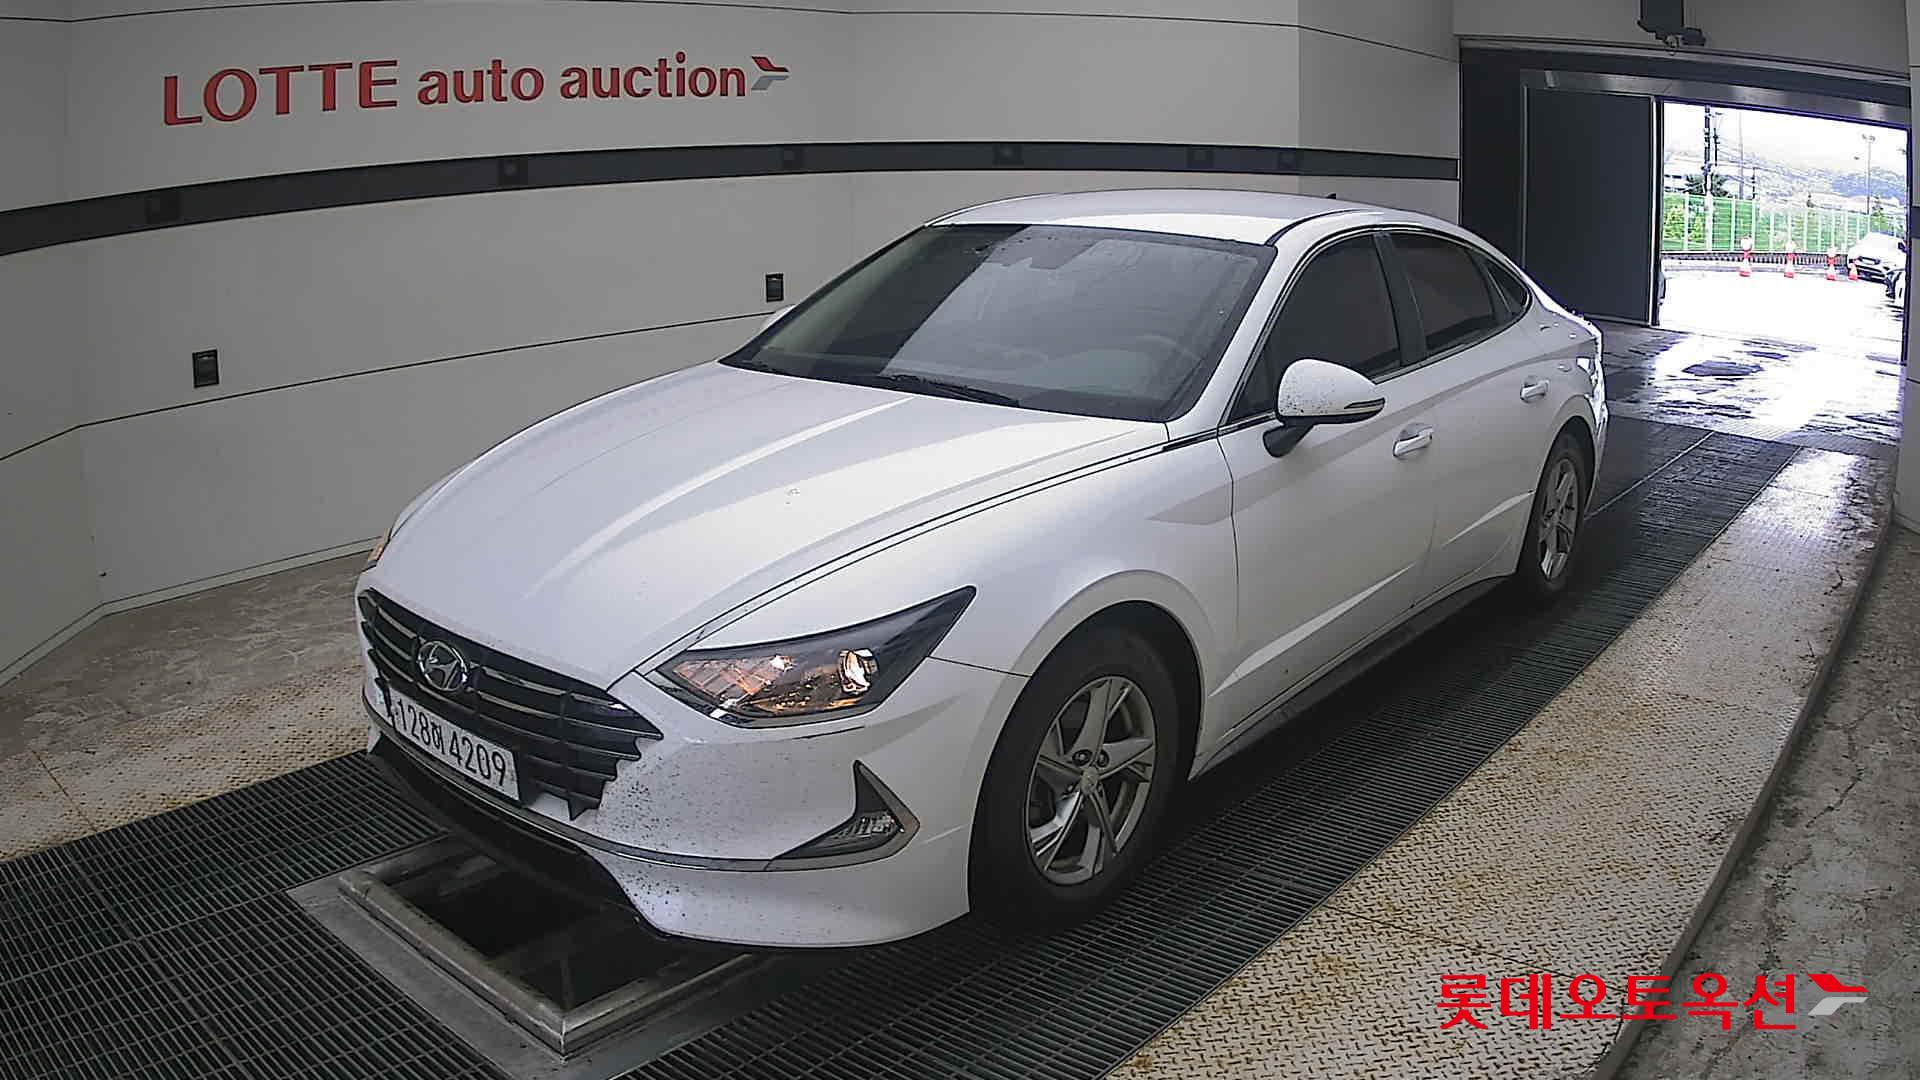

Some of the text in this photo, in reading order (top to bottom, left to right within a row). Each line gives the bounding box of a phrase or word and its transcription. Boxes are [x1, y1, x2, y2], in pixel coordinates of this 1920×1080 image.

[164, 51, 746, 126] LOTTE auto auction
[449, 731, 506, 786] 4209
